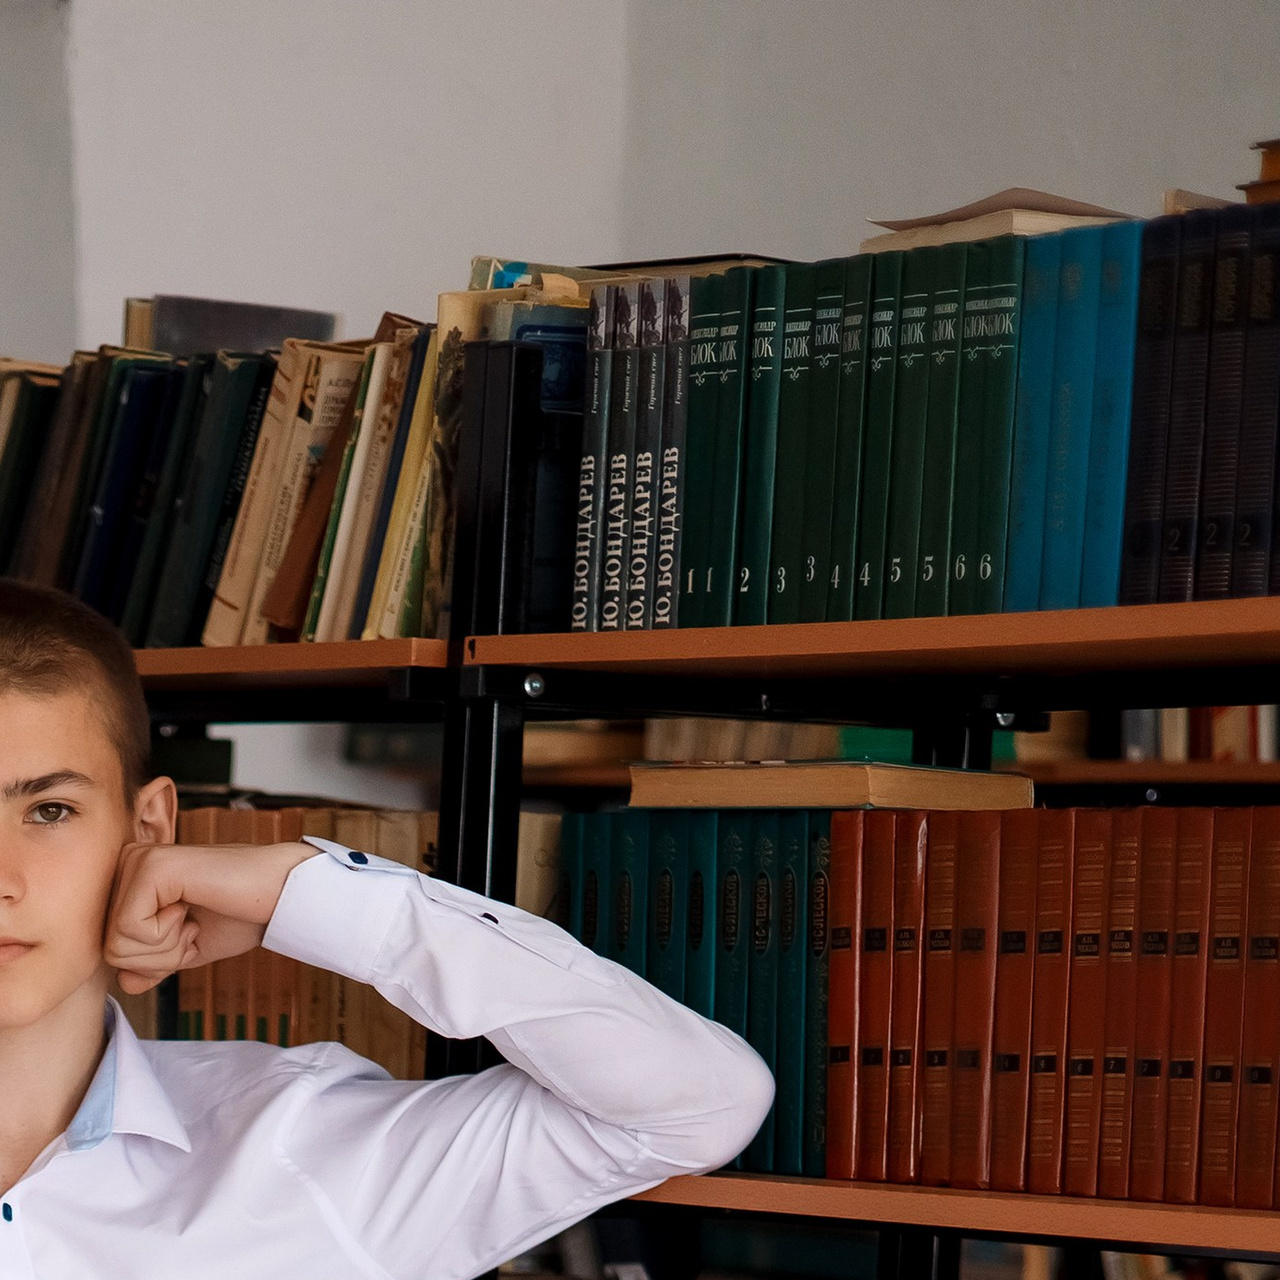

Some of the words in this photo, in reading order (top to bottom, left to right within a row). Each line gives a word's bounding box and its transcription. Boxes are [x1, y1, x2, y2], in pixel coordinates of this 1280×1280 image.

[815, 323, 841, 346] БЛОК
[901, 322, 925, 345] БЛОК
[932, 318, 956, 342] БЛОК
[691, 342, 716, 365] БЛОК
[784, 336, 810, 359] БЛОК
[575, 454, 596, 593] БОНДАРЕВ
[604, 453, 628, 592] БОНДАРЕВ
[630, 451, 654, 589] БОНДАРЕВ
[658, 446, 680, 587] БОНДАРЕВ
[1168, 528, 1180, 551] 2
[1206, 522, 1217, 545] 2
[1238, 523, 1251, 545] 2
[806, 555, 815, 582] 3
[831, 564, 840, 589] 4
[859, 562, 870, 586] 4
[891, 558, 901, 582] 5
[923, 556, 933, 581] 5
[955, 554, 966, 580] 6
[979, 553, 992, 580] 6
[687, 568, 695, 593] 1
[706, 567, 713, 593] 1
[740, 567, 750, 592] 2
[777, 566, 786, 593] 3
[572, 595, 587, 629] Ю.
[602, 596, 620, 629] Ю.
[628, 595, 645, 628] Ю.
[655, 591, 672, 625] Ю.
